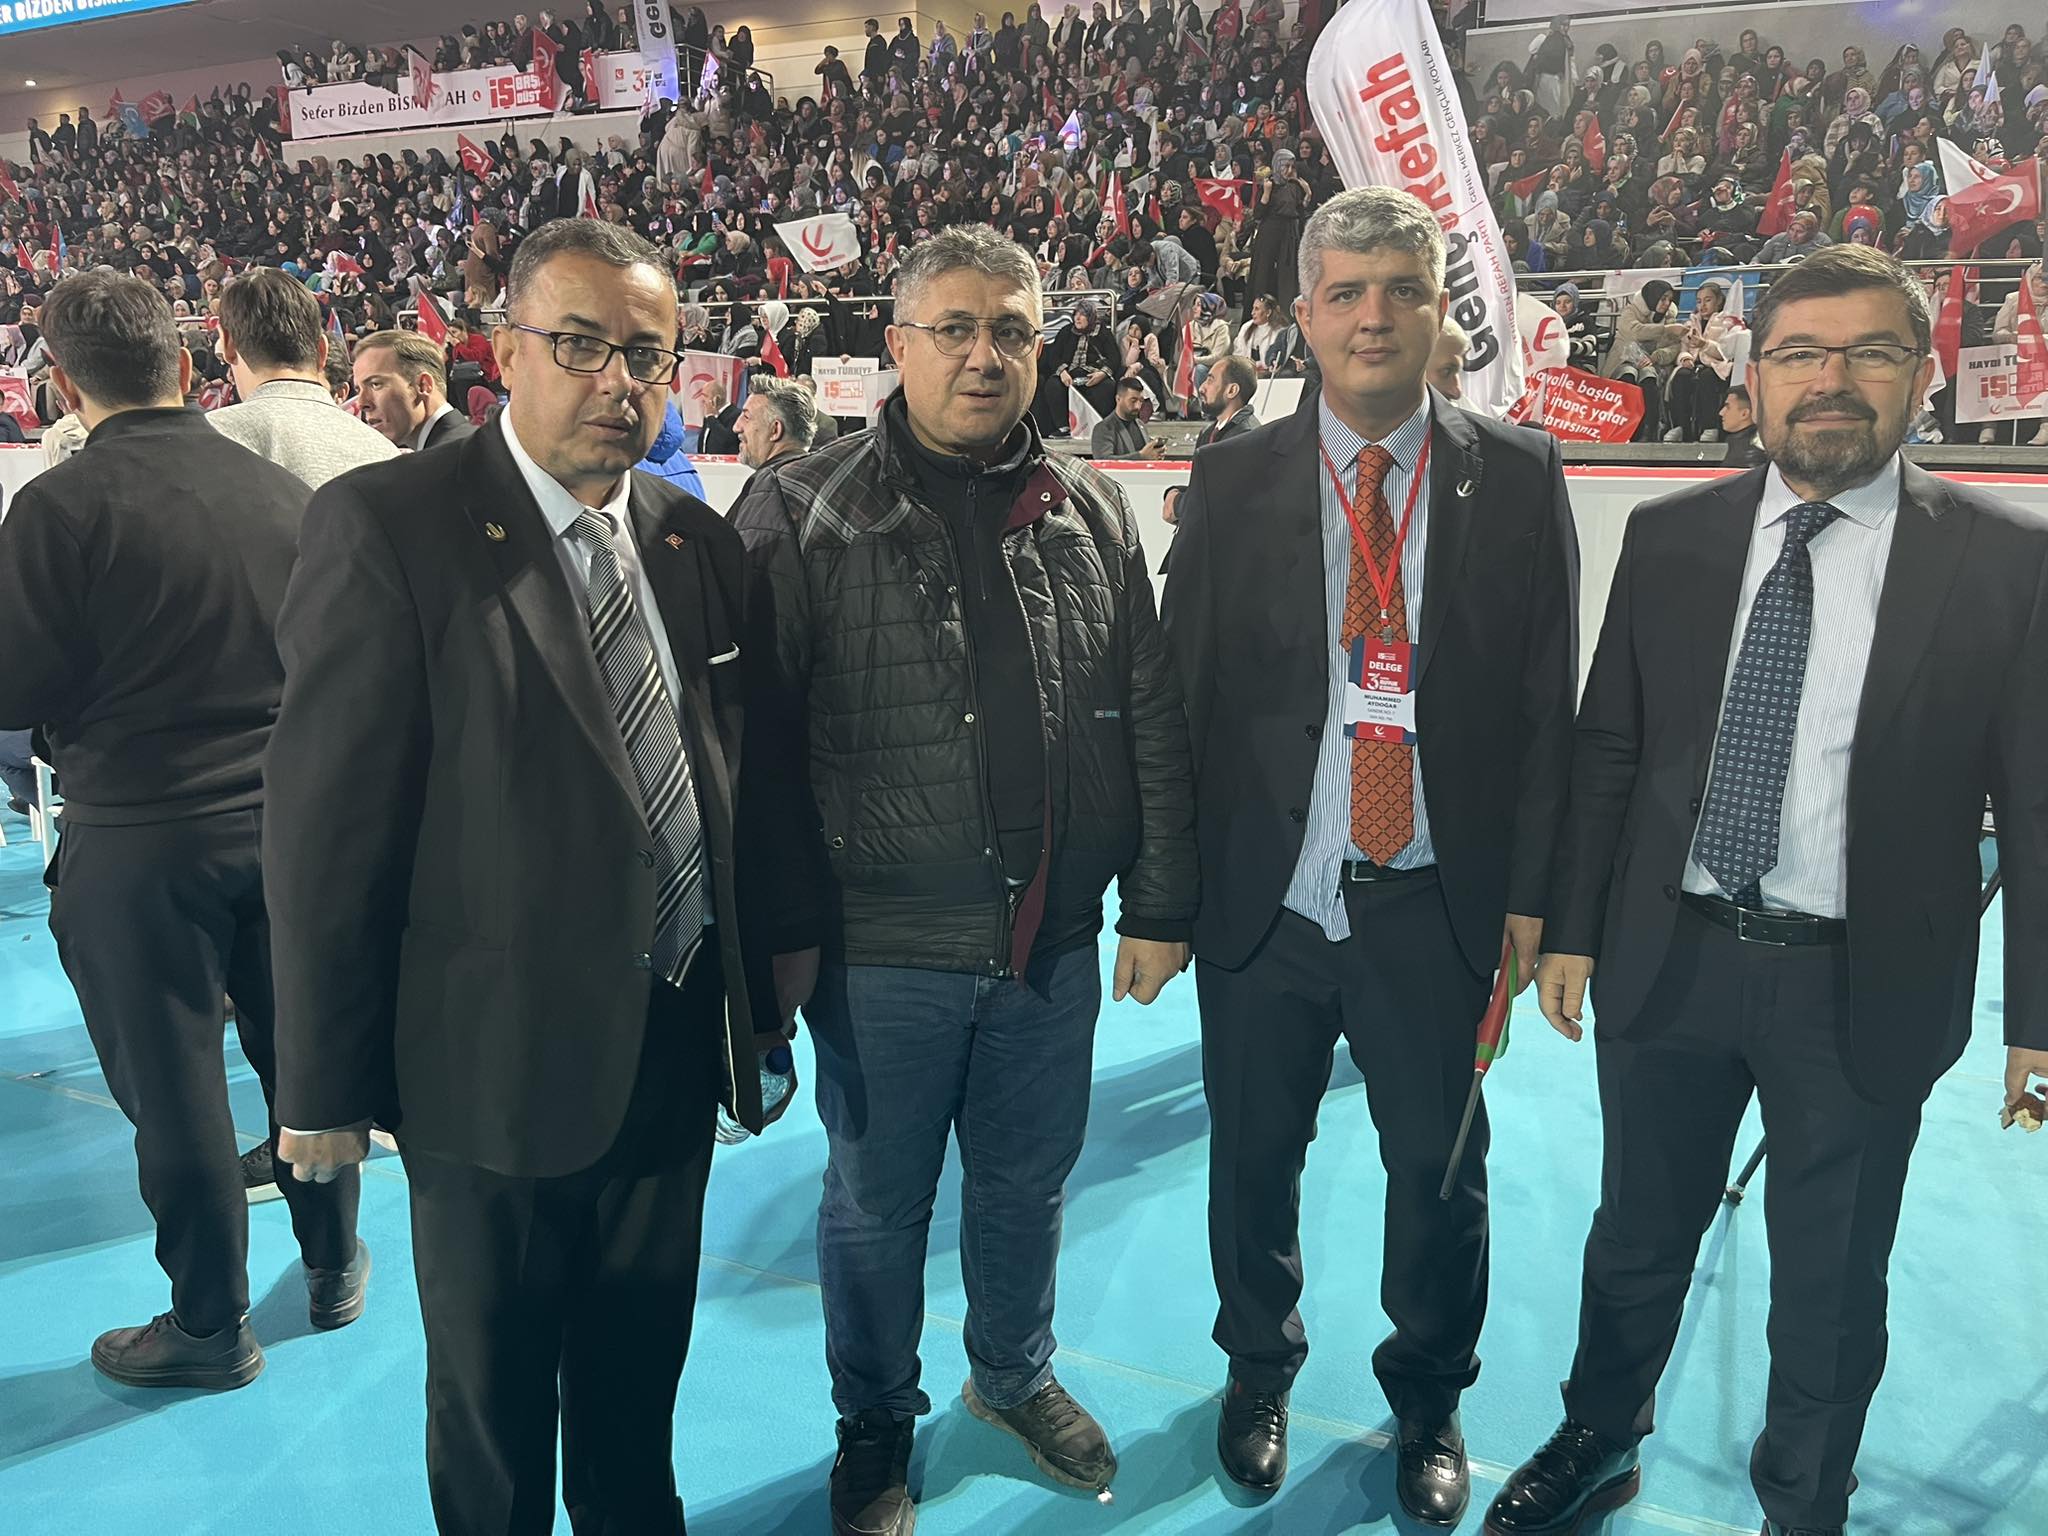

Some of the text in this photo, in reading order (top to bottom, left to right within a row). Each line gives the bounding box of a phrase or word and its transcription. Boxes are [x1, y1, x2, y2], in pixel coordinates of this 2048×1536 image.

[0, 4, 14, 24] R
[644, 0, 667, 38] Ge
[632, 68, 645, 92] 3
[1419, 39, 1441, 86] KOLLARI
[301, 105, 335, 121] Sefer
[338, 99, 384, 117] Bizden
[1449, 129, 1469, 168] MERKEZ
[1460, 168, 1478, 204] GENEL
[1359, 51, 1500, 373] Genç Refah
[1488, 254, 1509, 295] REFAH
[1550, 391, 1588, 419] inanç
[1591, 405, 1629, 427] yatar
[1366, 672, 1381, 690] 3
[1368, 660, 1403, 673] DELEGE
[1364, 694, 1402, 704] MUHAMMED
